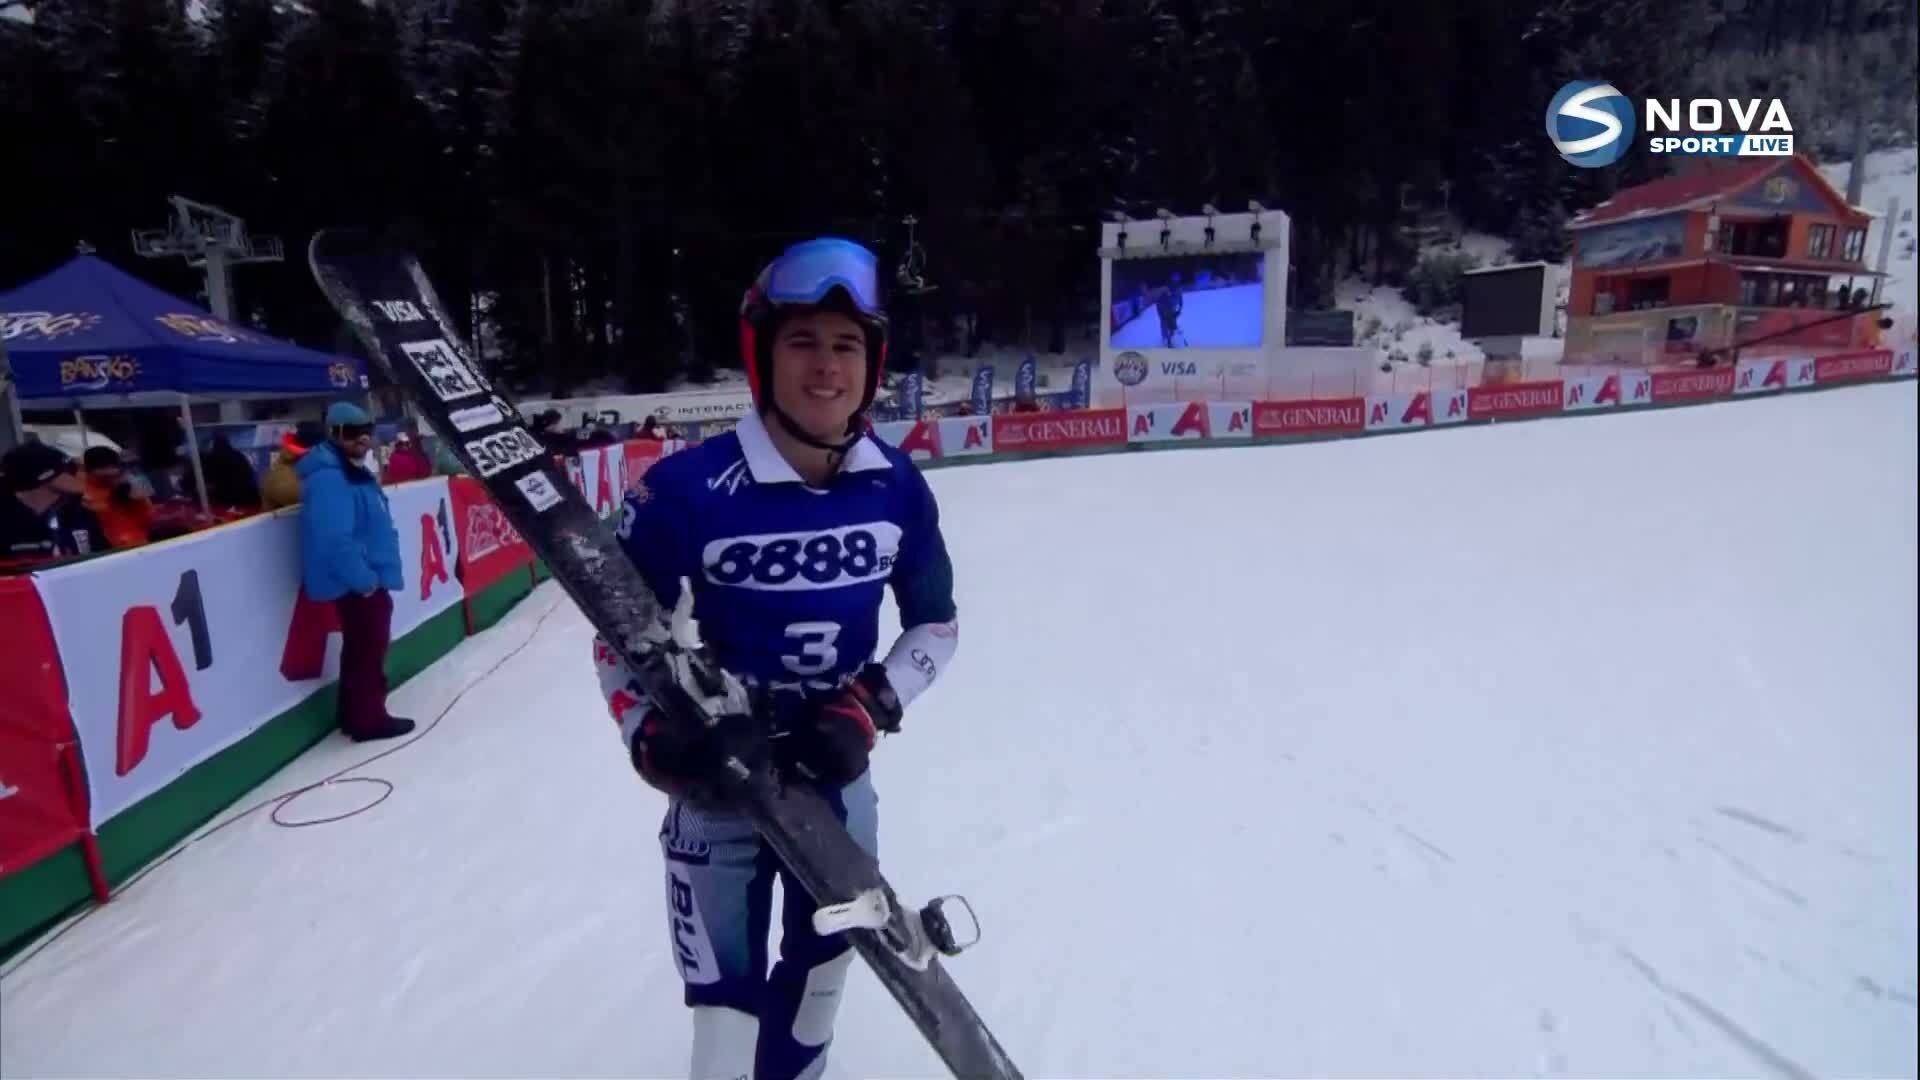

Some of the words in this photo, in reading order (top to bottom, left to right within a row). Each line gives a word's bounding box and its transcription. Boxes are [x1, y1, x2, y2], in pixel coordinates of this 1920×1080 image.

[373, 301, 424, 321] VISA
[1161, 362, 1196, 375] VISA
[1282, 406, 1360, 427] GENERALI
[1371, 402, 1388, 425] A1
[1448, 395, 1465, 417] A1
[1028, 415, 1121, 441] GENERALI
[1134, 411, 1155, 436] A1
[1228, 408, 1249, 432] A1
[964, 422, 988, 449] A1
[420, 498, 451, 600] A1
[781, 621, 841, 675] 3
[116, 569, 213, 777] A1
